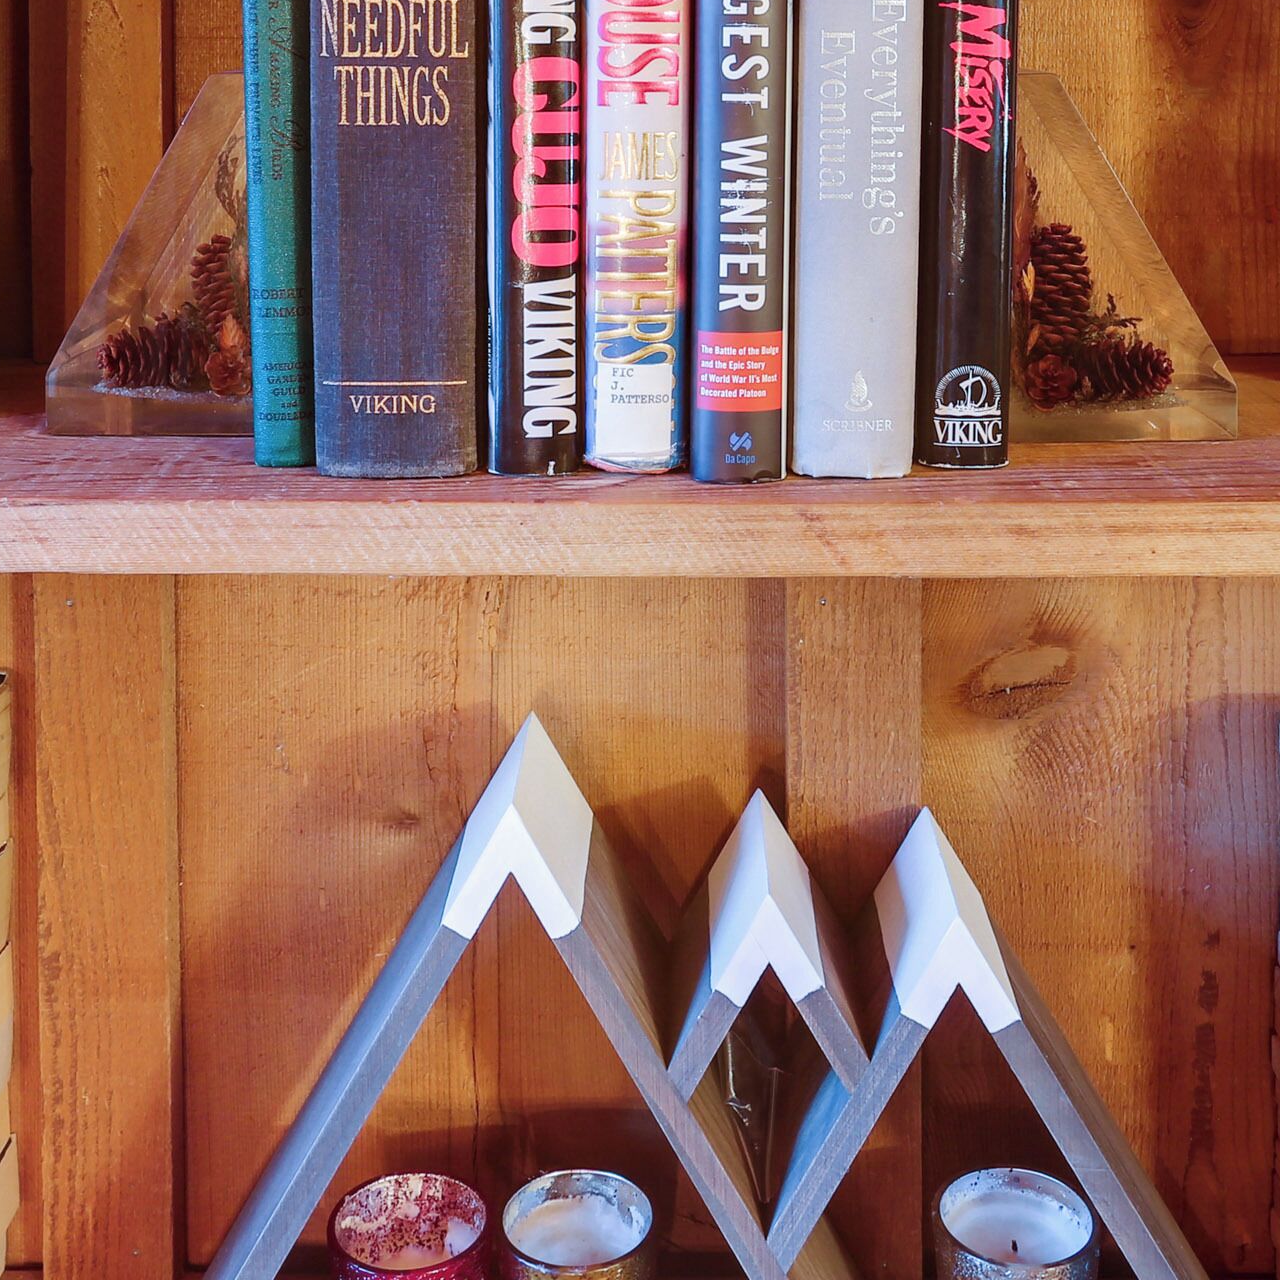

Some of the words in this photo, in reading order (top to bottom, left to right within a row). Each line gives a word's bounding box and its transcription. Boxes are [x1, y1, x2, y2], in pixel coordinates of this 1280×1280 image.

[333, 66, 451, 126] THINGS
[820, 29, 856, 201] Eventual
[511, 56, 580, 267] CUJO
[598, 131, 680, 182] JAMES
[716, 135, 769, 313] WINTER
[595, 189, 677, 431] PATTERS
[522, 273, 578, 439] VIKING
[701, 344, 713, 354] The
[714, 345, 737, 356] Battle
[738, 346, 746, 356] of
[748, 346, 760, 355] the
[612, 367, 634, 378] FIC
[701, 360, 713, 369] and
[715, 360, 727, 369] the
[729, 361, 745, 371] Epic
[746, 361, 765, 371] Story
[611, 381, 625, 391] J.
[709, 374, 731, 384] World
[732, 375, 747, 384] War
[762, 373, 778, 383] Most
[611, 394, 670, 404] PATTERSO
[700, 387, 738, 398] Decorated
[739, 389, 767, 398] Platoon
[350, 393, 437, 416] VIKING
[822, 419, 894, 432] SCRIBNER
[933, 420, 1002, 444] VIKING
[725, 454, 735, 464] Da
[737, 454, 756, 465] Capo
